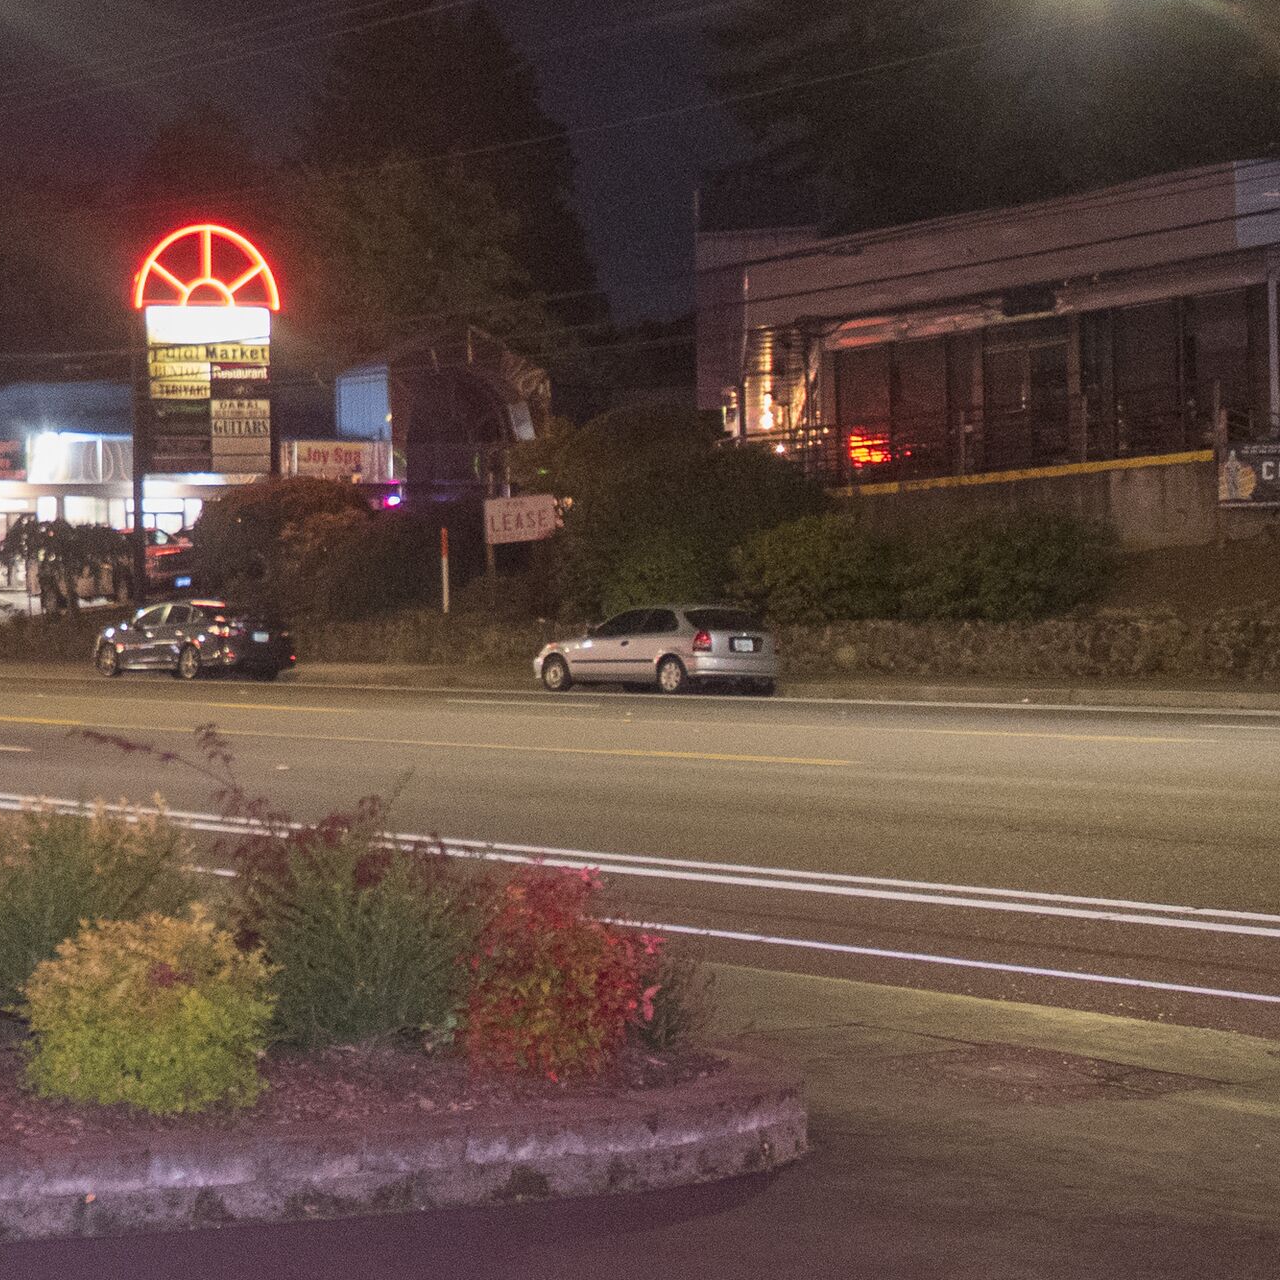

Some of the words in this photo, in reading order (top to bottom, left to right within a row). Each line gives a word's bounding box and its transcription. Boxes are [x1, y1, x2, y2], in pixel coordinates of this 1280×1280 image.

[206, 345, 268, 361] Market
[213, 421, 268, 436] GUITARS
[303, 447, 329, 464] Joy
[333, 447, 361, 465] Spa
[490, 509, 549, 532] LEASE
